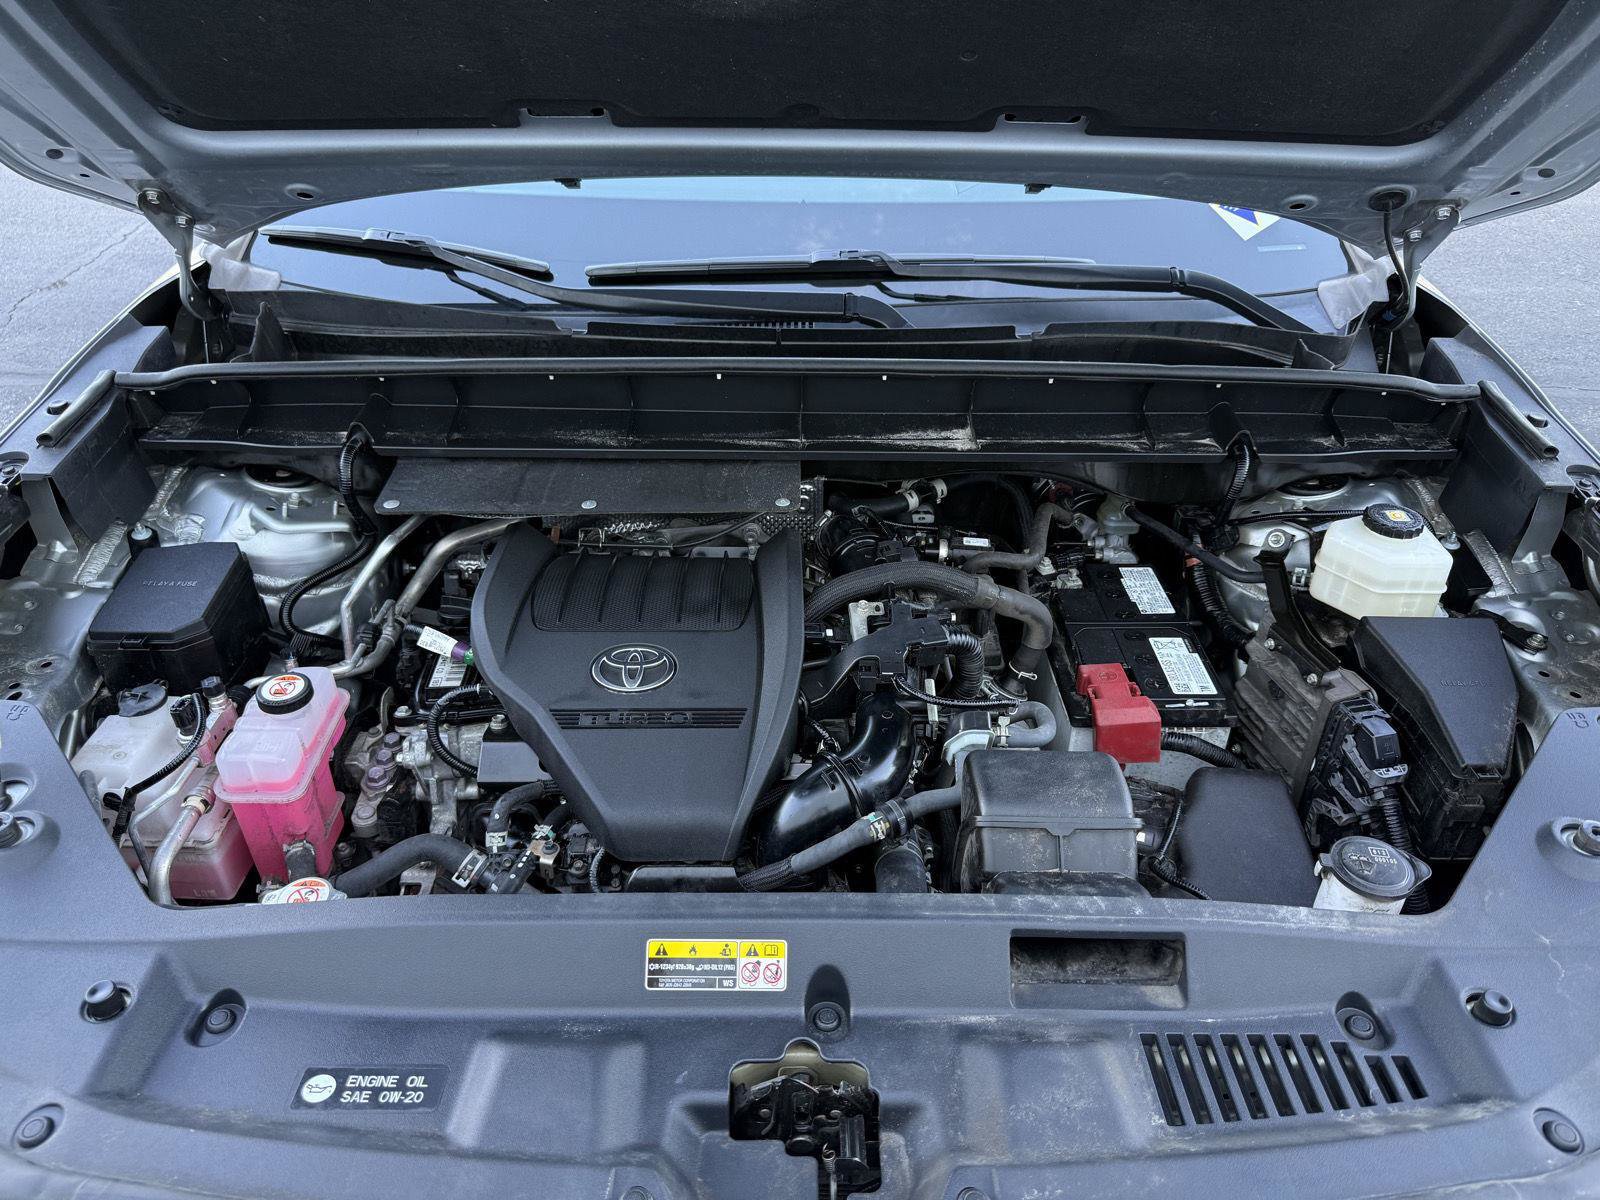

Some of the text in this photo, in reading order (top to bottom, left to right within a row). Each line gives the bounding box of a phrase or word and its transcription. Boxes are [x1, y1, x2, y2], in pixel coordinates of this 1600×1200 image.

[722, 979, 734, 987] WS
[345, 1075, 429, 1088] ENGINE OIL
[339, 1090, 424, 1103] SAE 0W-20
